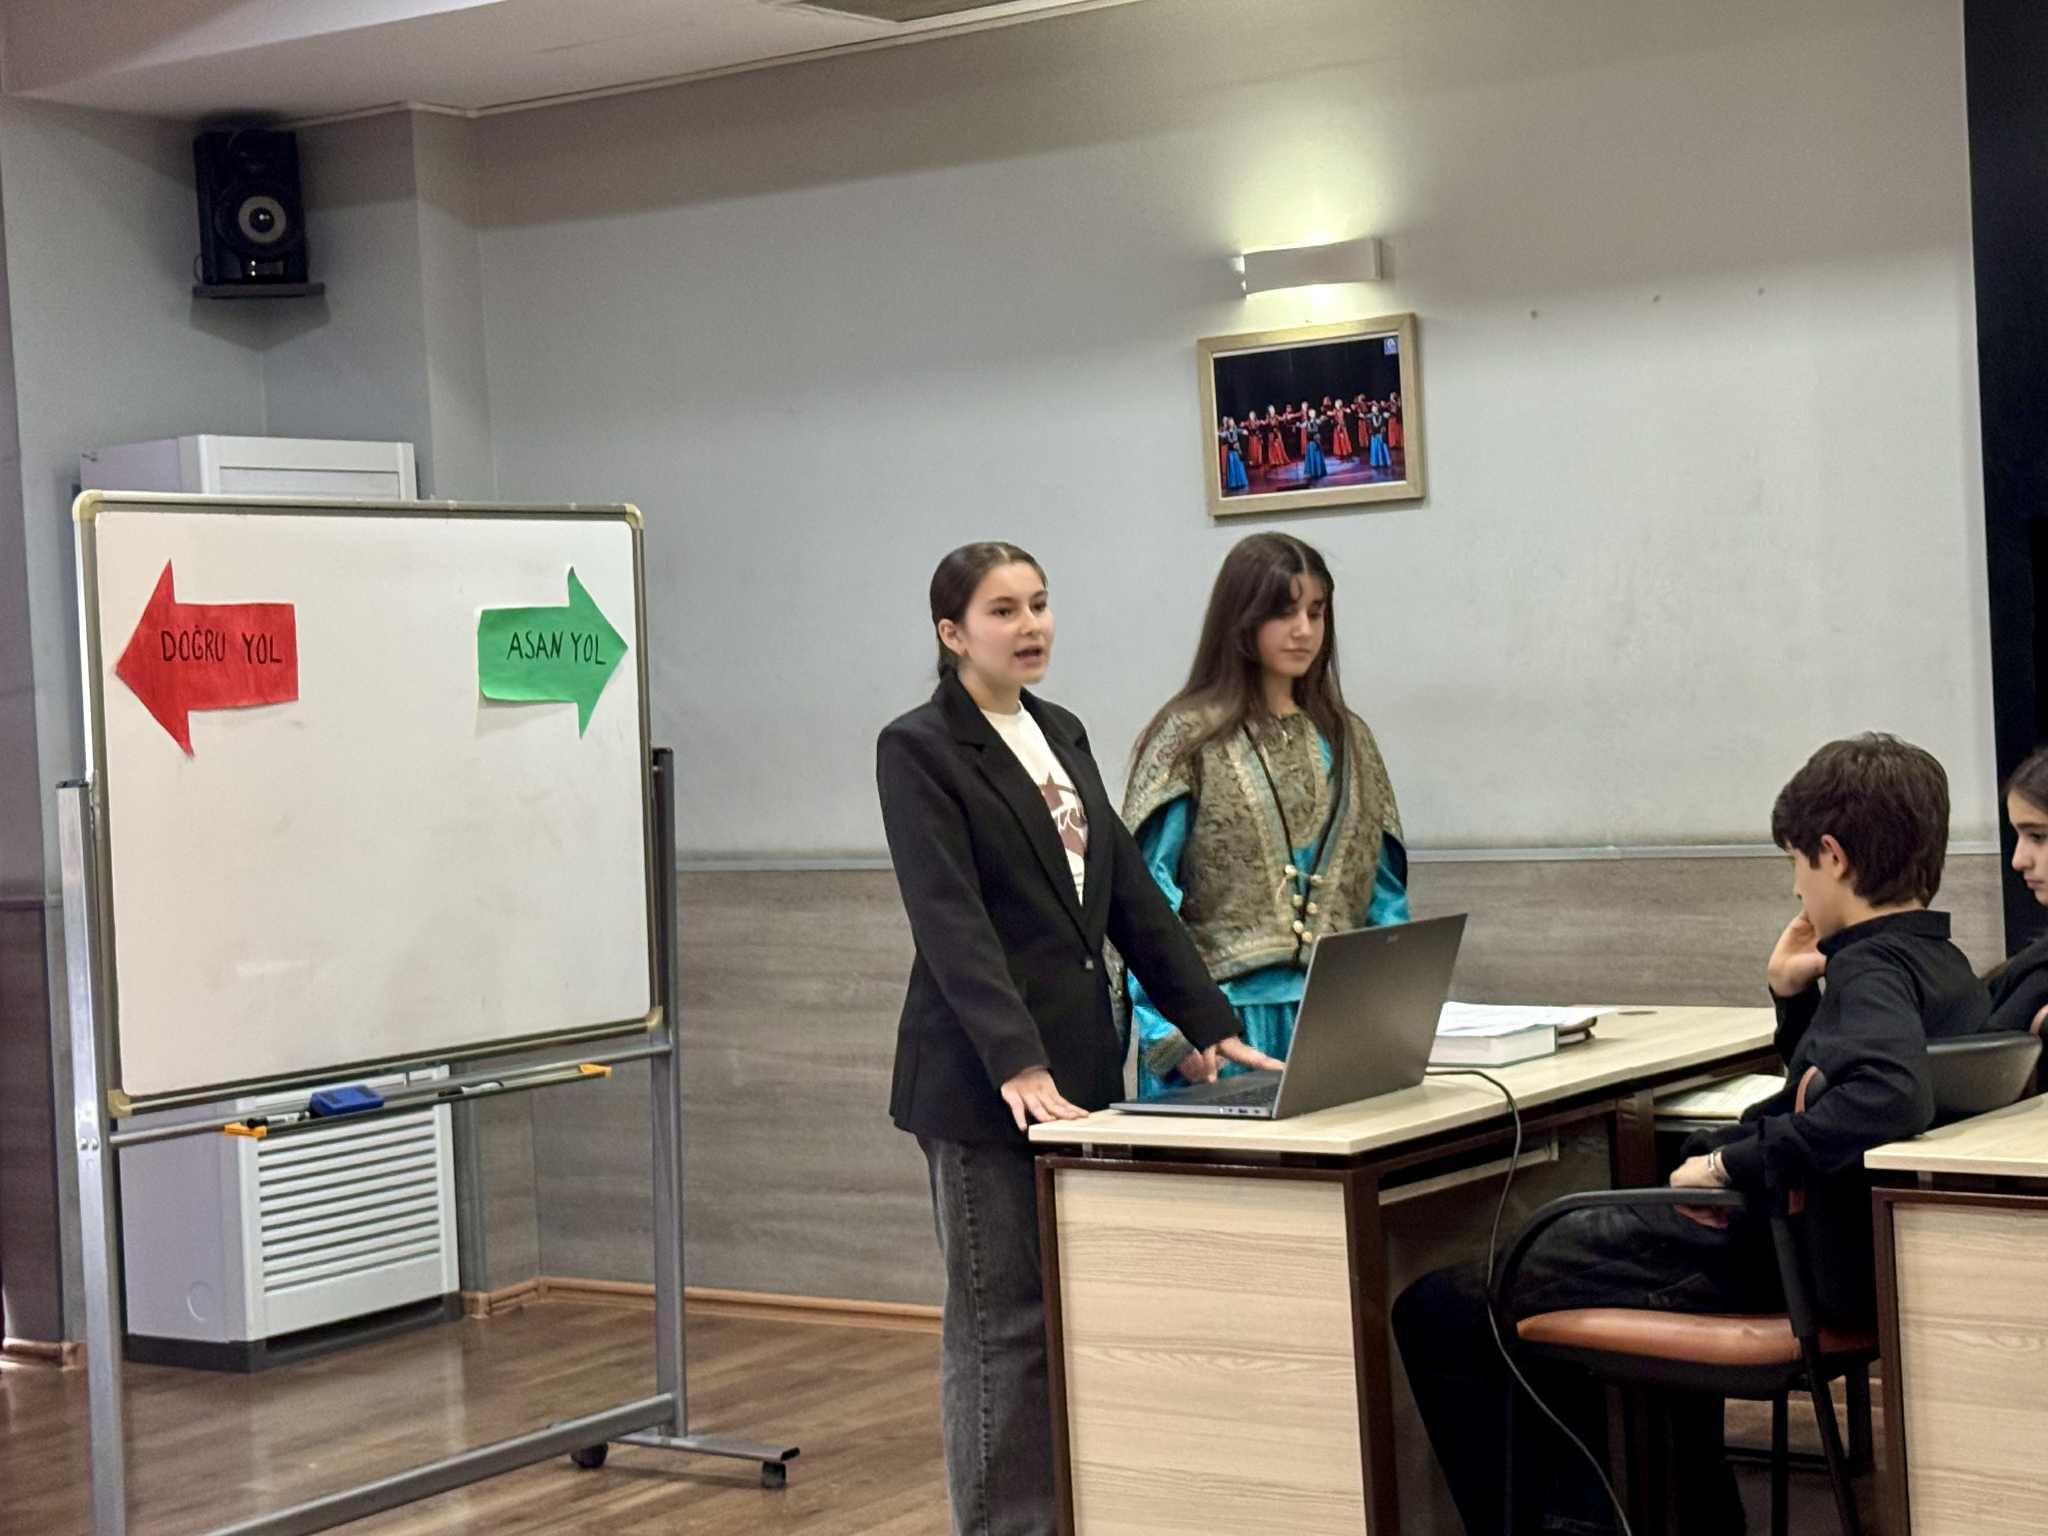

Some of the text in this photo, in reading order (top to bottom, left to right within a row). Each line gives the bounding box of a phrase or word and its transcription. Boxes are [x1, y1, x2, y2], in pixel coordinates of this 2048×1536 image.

[241, 632, 283, 664] YOL
[506, 630, 607, 665] ASAN YOL
